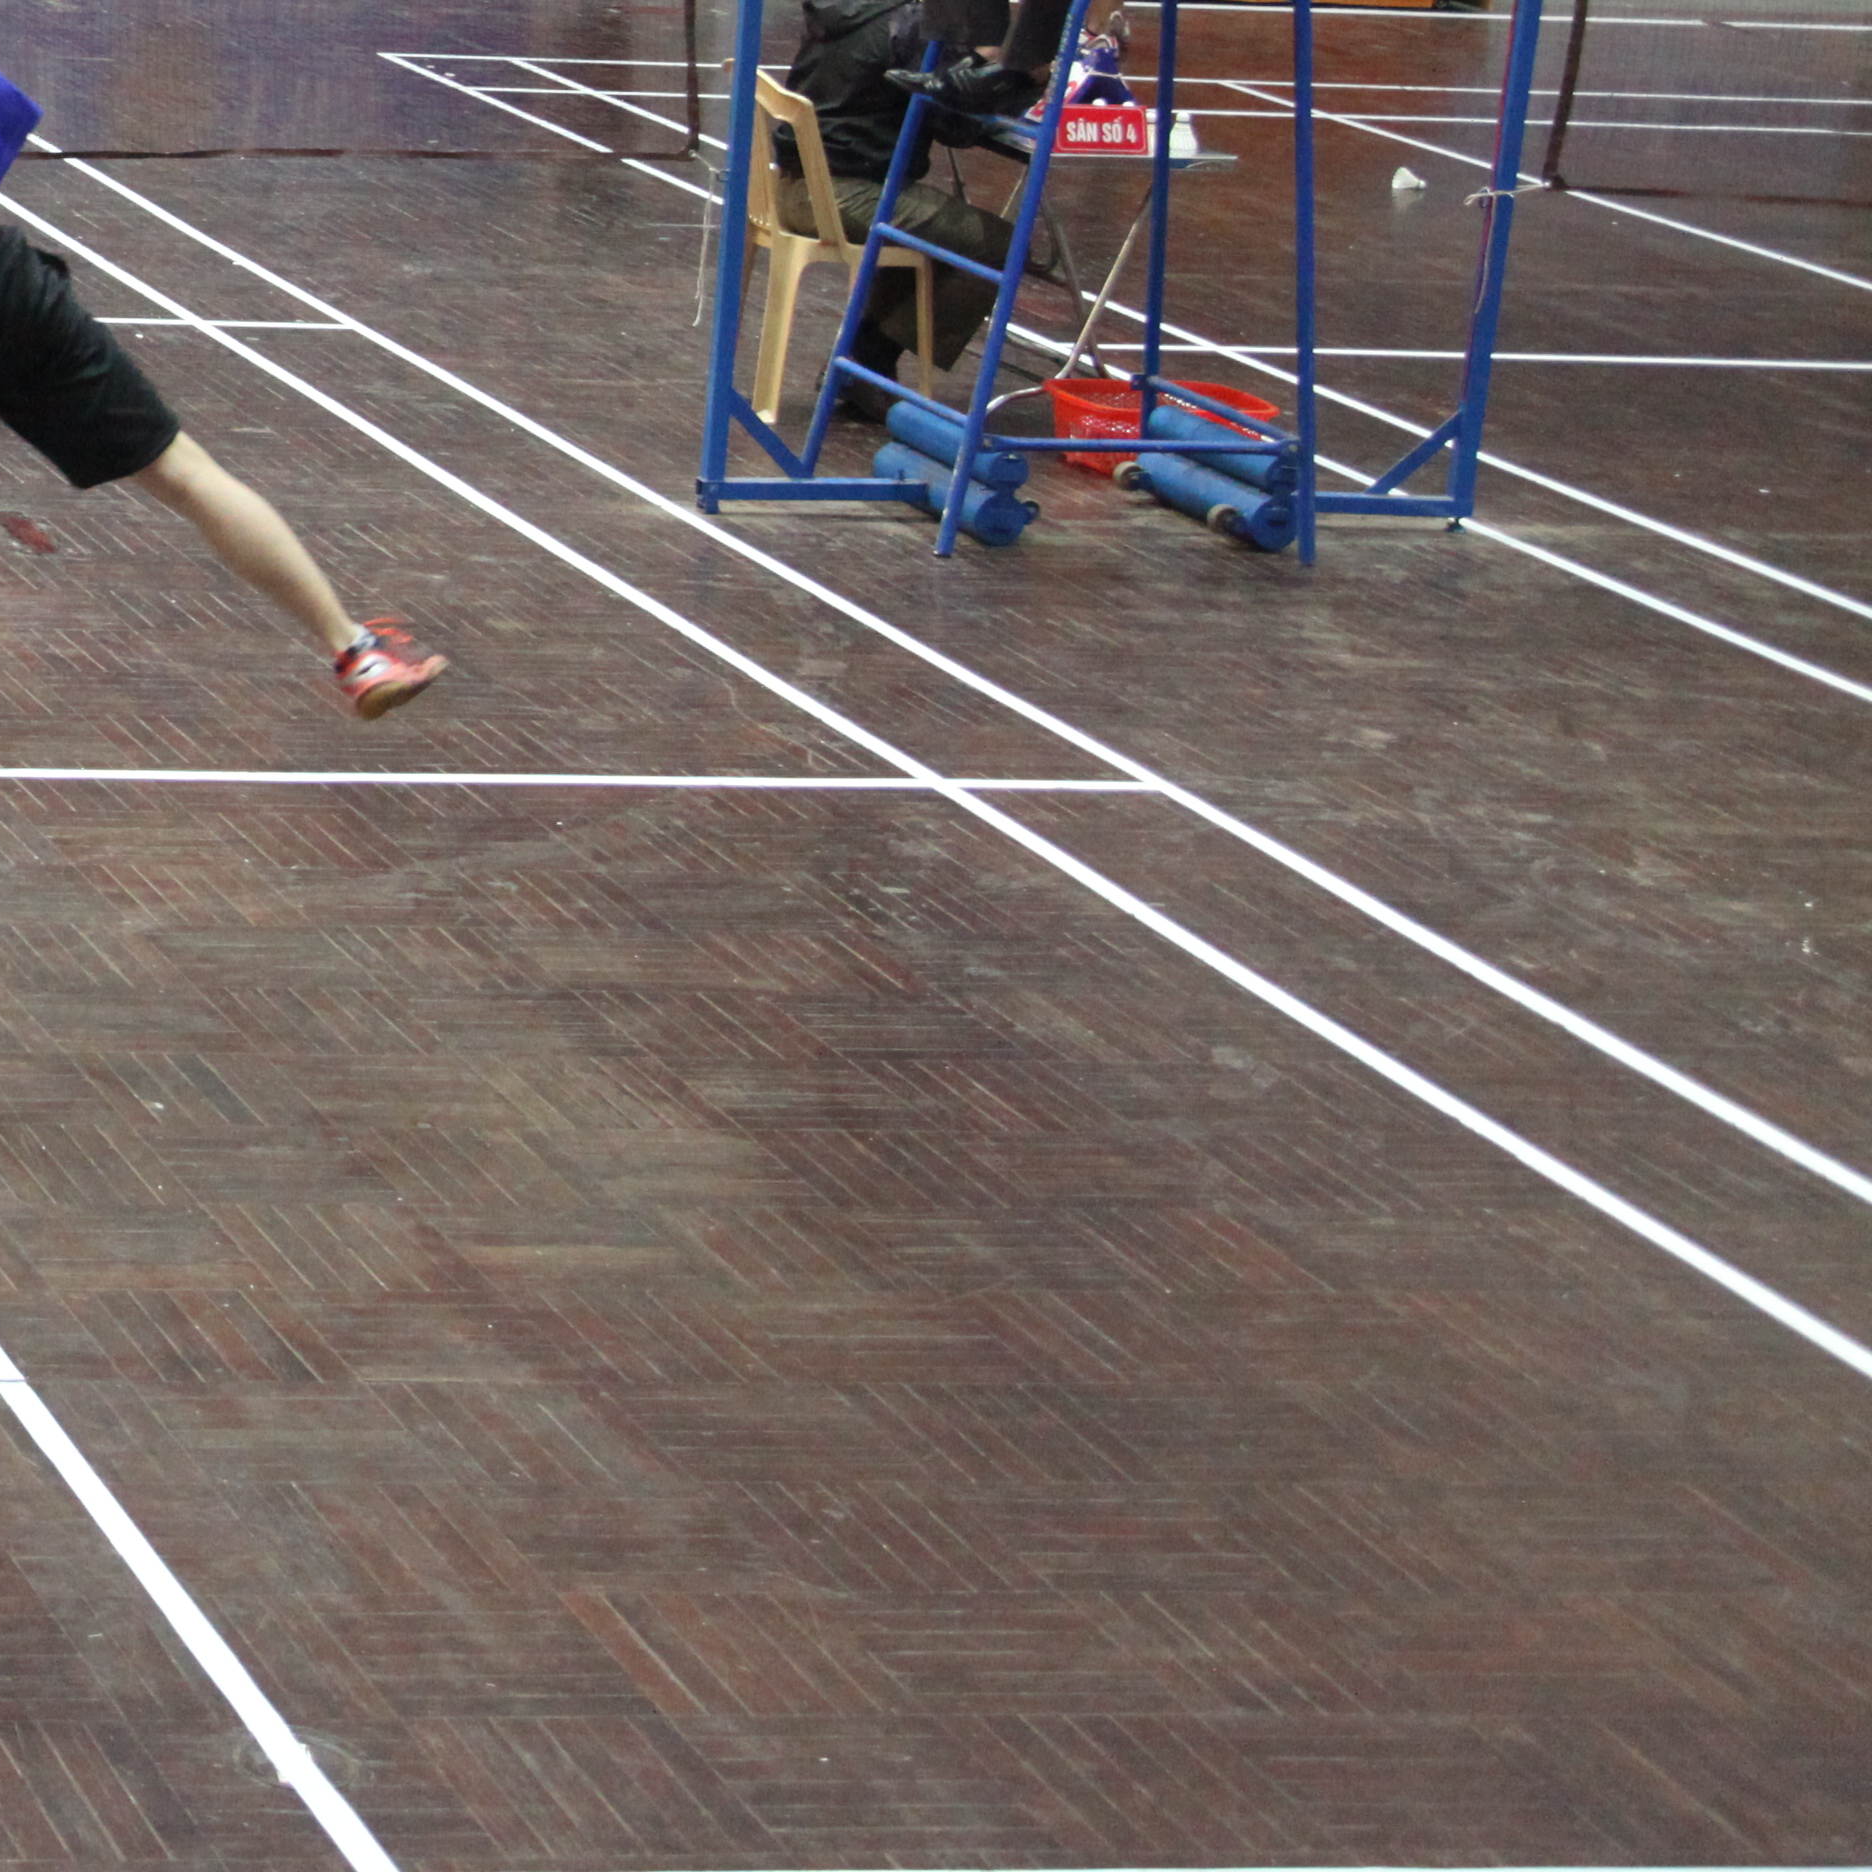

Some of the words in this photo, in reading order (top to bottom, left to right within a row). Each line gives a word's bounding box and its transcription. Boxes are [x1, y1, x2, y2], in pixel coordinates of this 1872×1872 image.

[1066, 117, 1098, 143] SÂN
[1102, 115, 1121, 143] SỐ
[1126, 123, 1137, 143] 4
